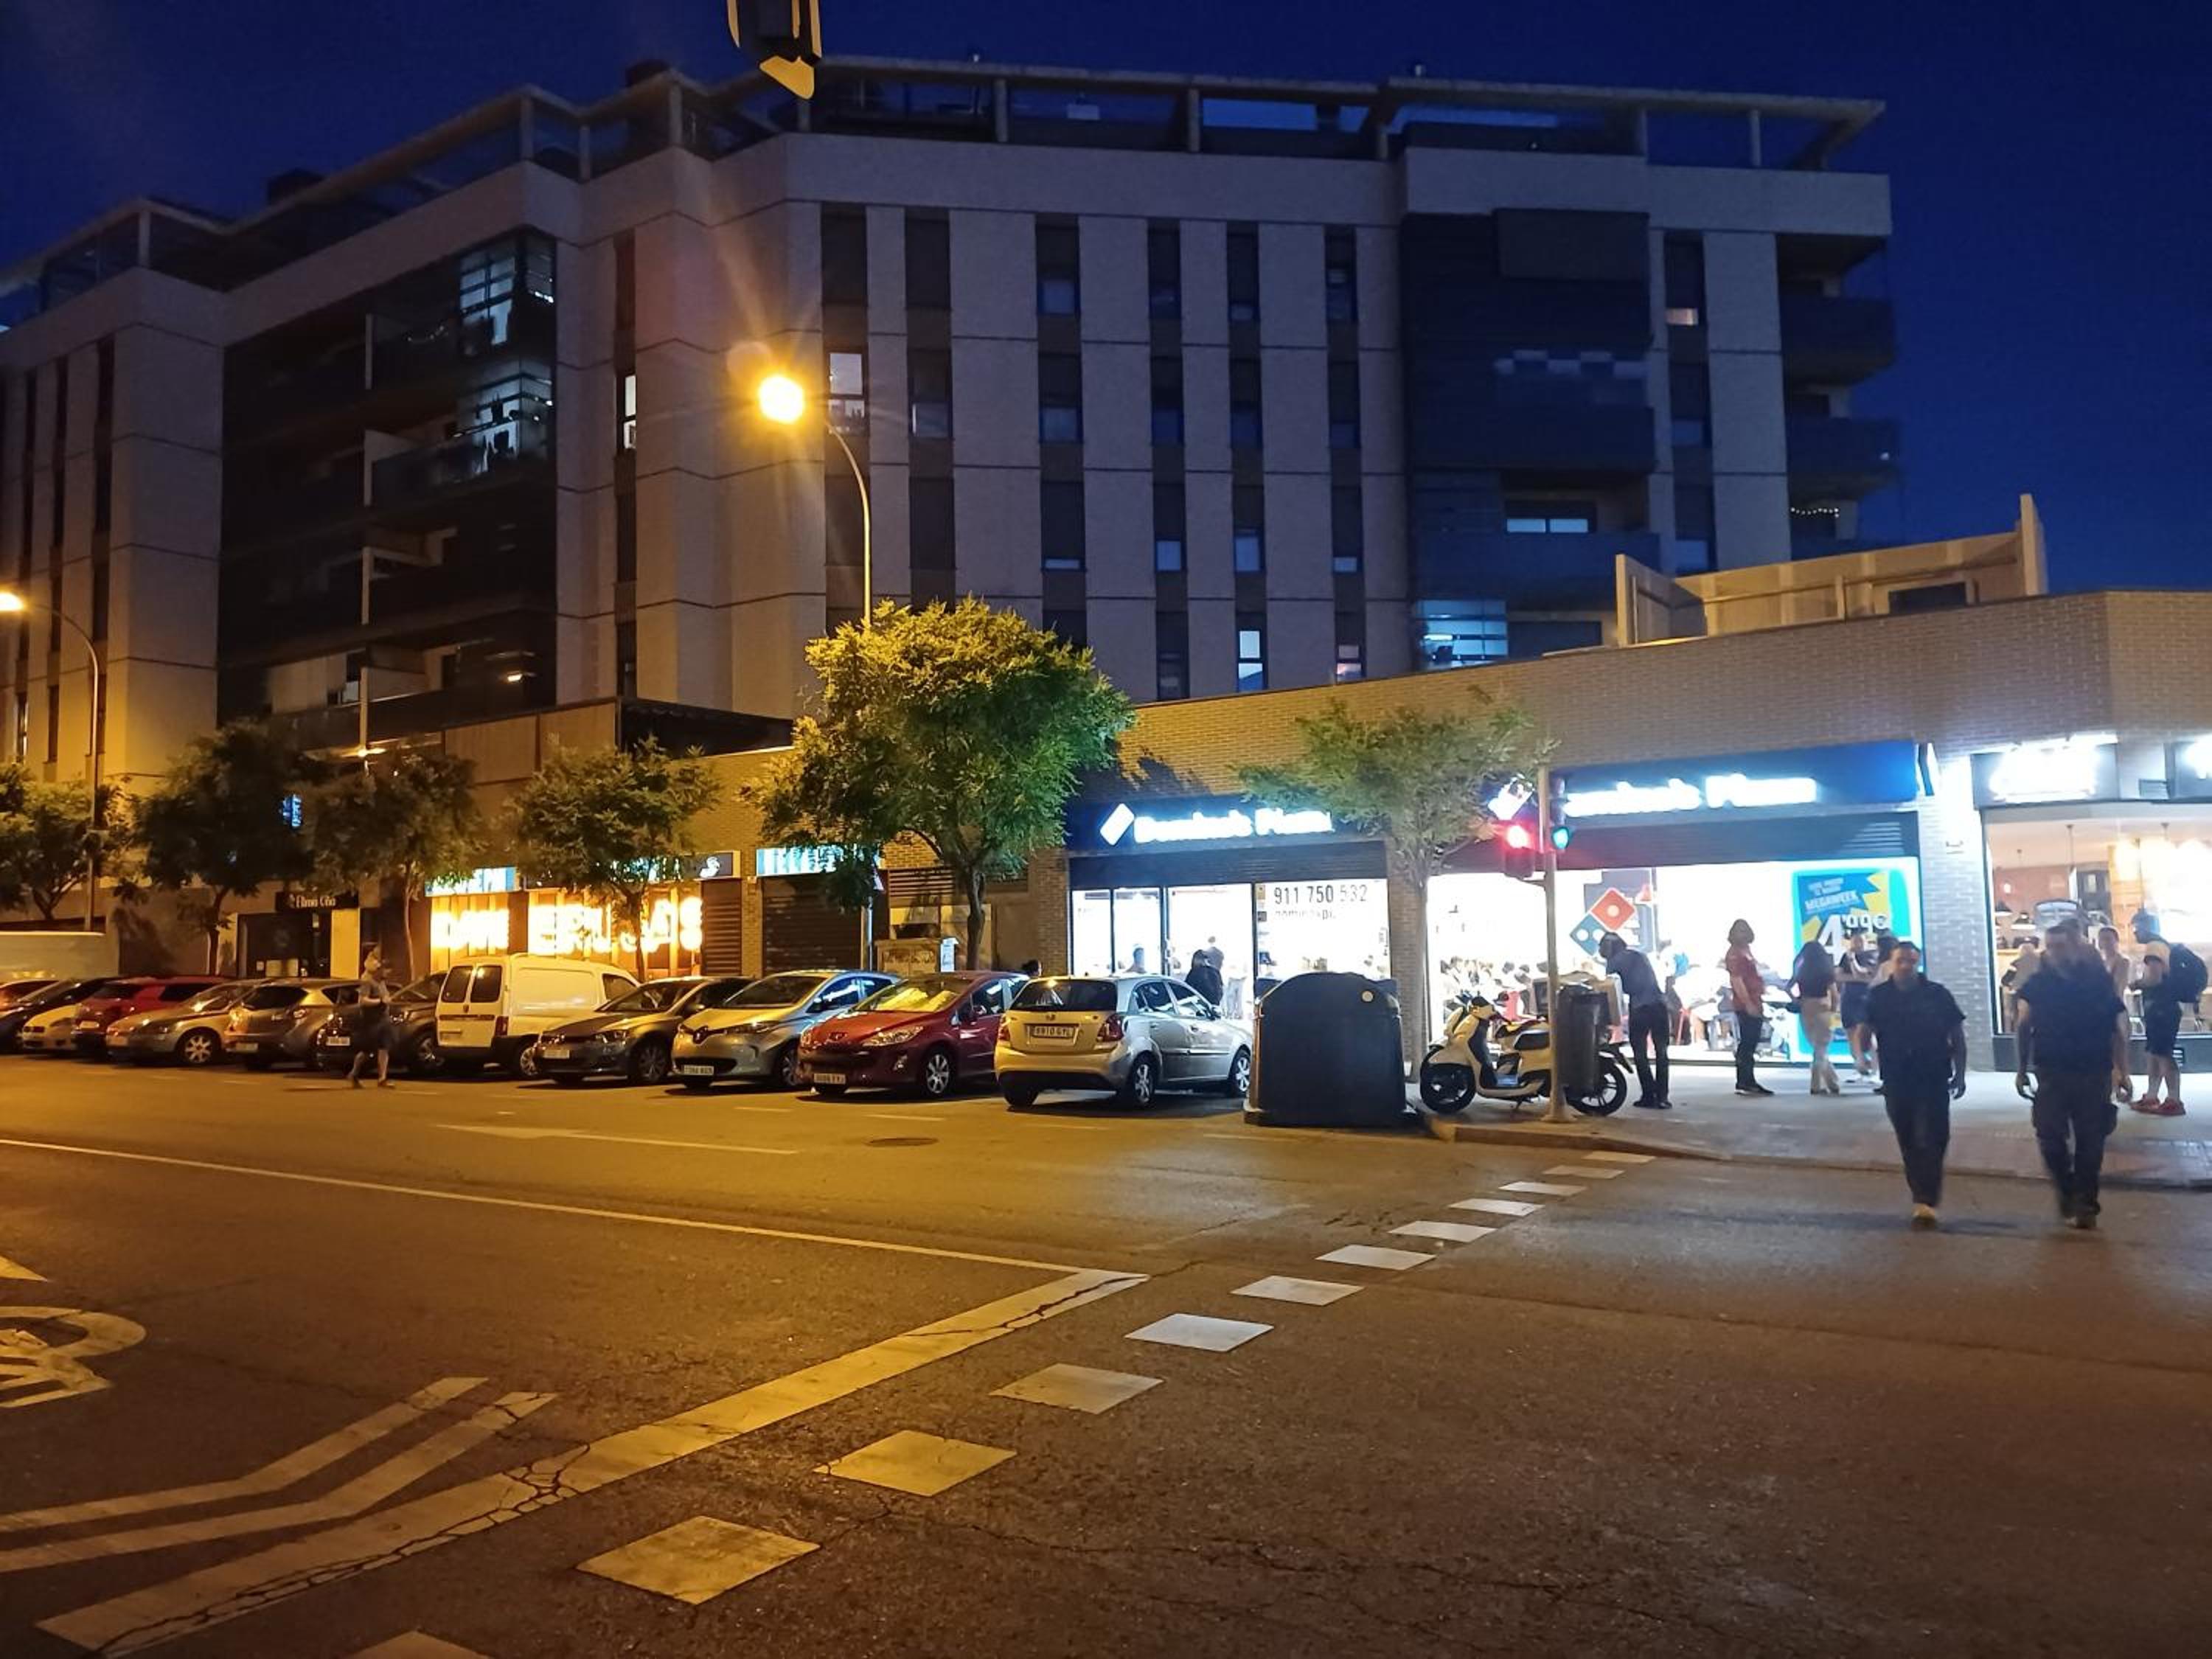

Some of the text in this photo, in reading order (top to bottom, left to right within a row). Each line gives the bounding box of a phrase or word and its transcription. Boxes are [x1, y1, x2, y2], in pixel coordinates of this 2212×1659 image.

[1274, 884, 1368, 905] 911 750 532
